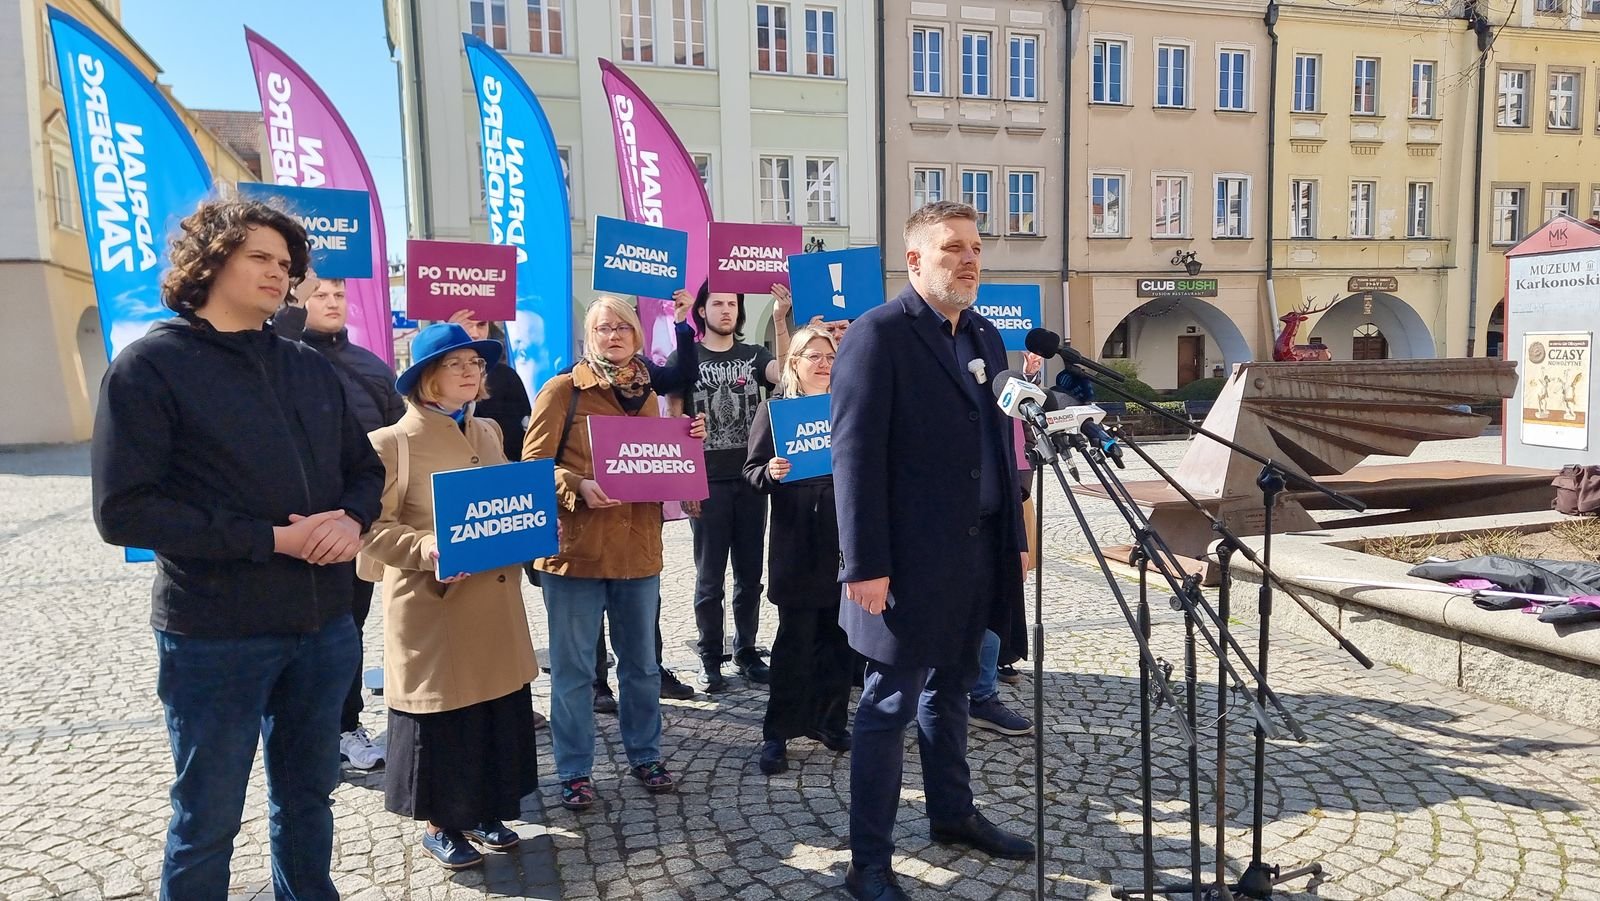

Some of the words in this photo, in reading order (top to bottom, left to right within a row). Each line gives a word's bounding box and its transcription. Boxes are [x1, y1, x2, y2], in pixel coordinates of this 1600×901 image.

[297, 216, 359, 233] WOJEJ
[304, 234, 347, 250] ONIE
[1548, 228, 1568, 241] MK
[616, 243, 668, 263] ADRIAN
[730, 245, 782, 259] ADRIAN
[418, 265, 442, 280] PO
[446, 267, 507, 282] TWOJEJ
[604, 255, 678, 278] ZANDBERG
[1530, 261, 1580, 276] MUZEUM
[430, 282, 496, 297] STRONIE
[1141, 280, 1176, 291] CLUB
[1177, 280, 1216, 291] SUSHI
[1548, 349, 1585, 361] CZASY
[1053, 413, 1074, 421] RADIO
[796, 420, 831, 438] ADRI
[618, 443, 681, 457] ADRIAN
[785, 435, 831, 455] ZANDB
[606, 459, 696, 474] ZANDBERG
[465, 493, 534, 521] ADRIAN
[450, 510, 547, 544] ZANDBERG
